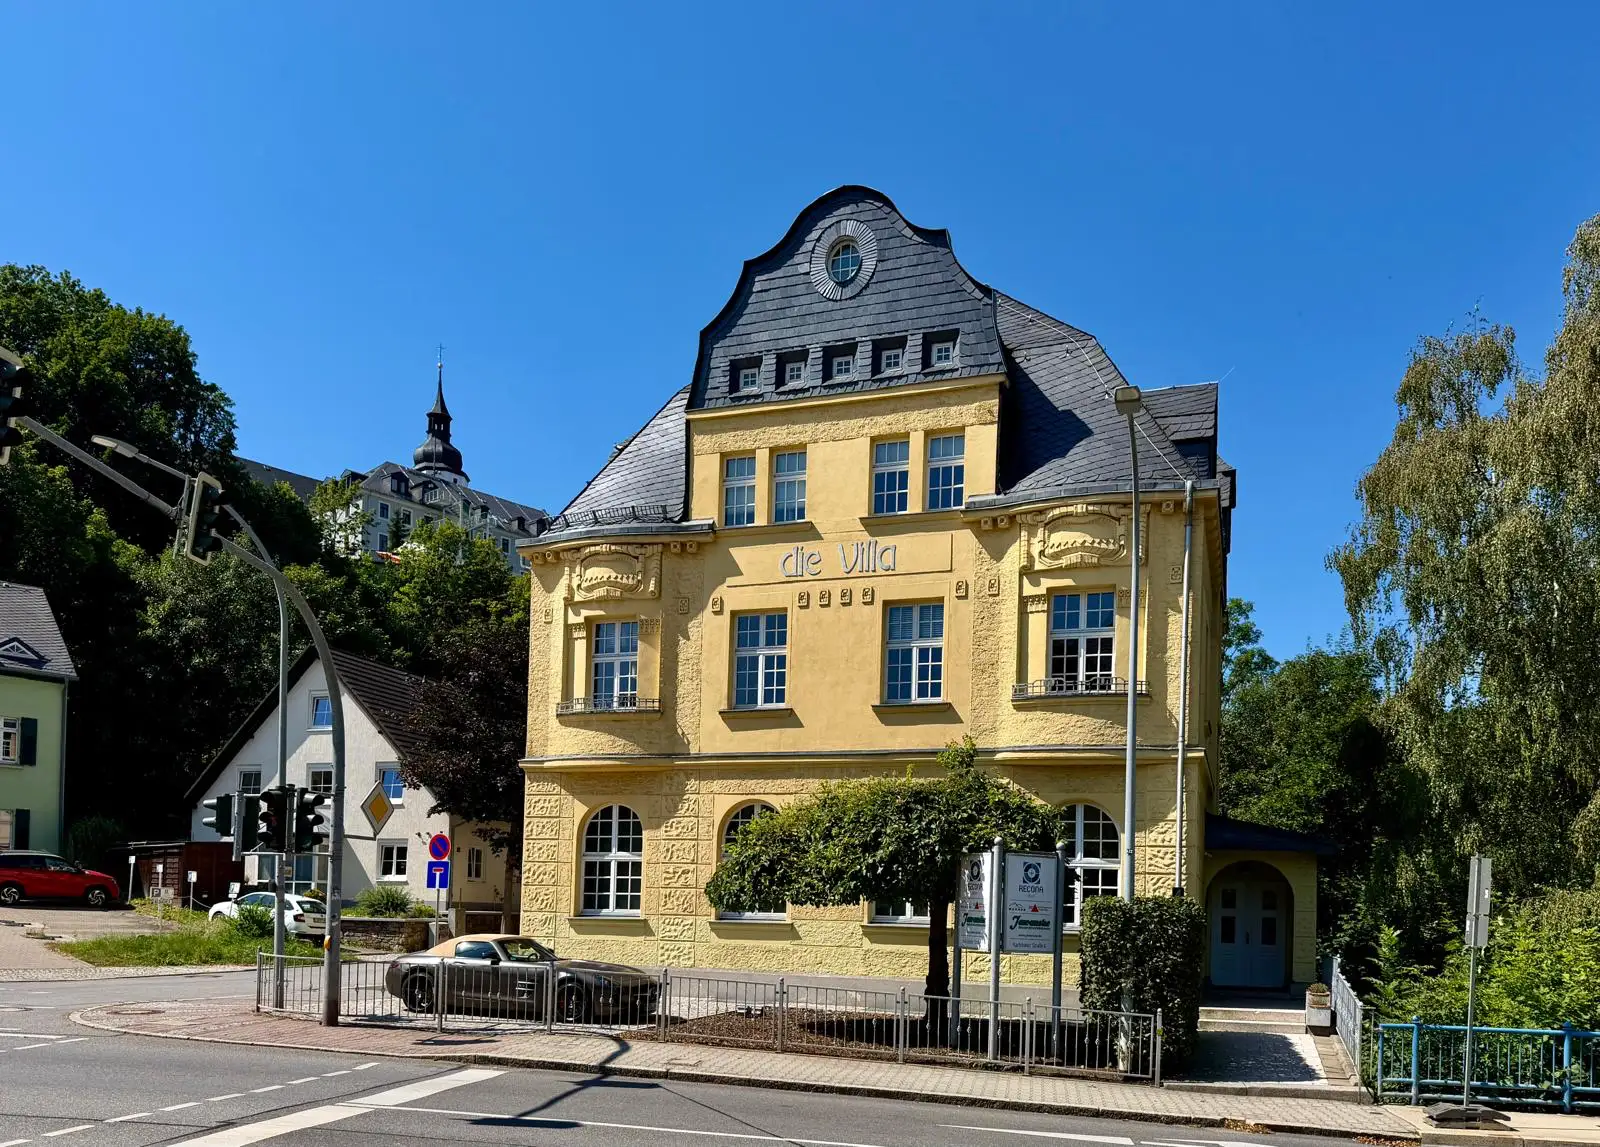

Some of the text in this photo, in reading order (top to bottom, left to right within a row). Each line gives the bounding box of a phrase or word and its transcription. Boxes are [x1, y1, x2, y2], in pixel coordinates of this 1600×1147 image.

[780, 539, 897, 577] die Villa
[1018, 884, 1044, 893] RECONA
